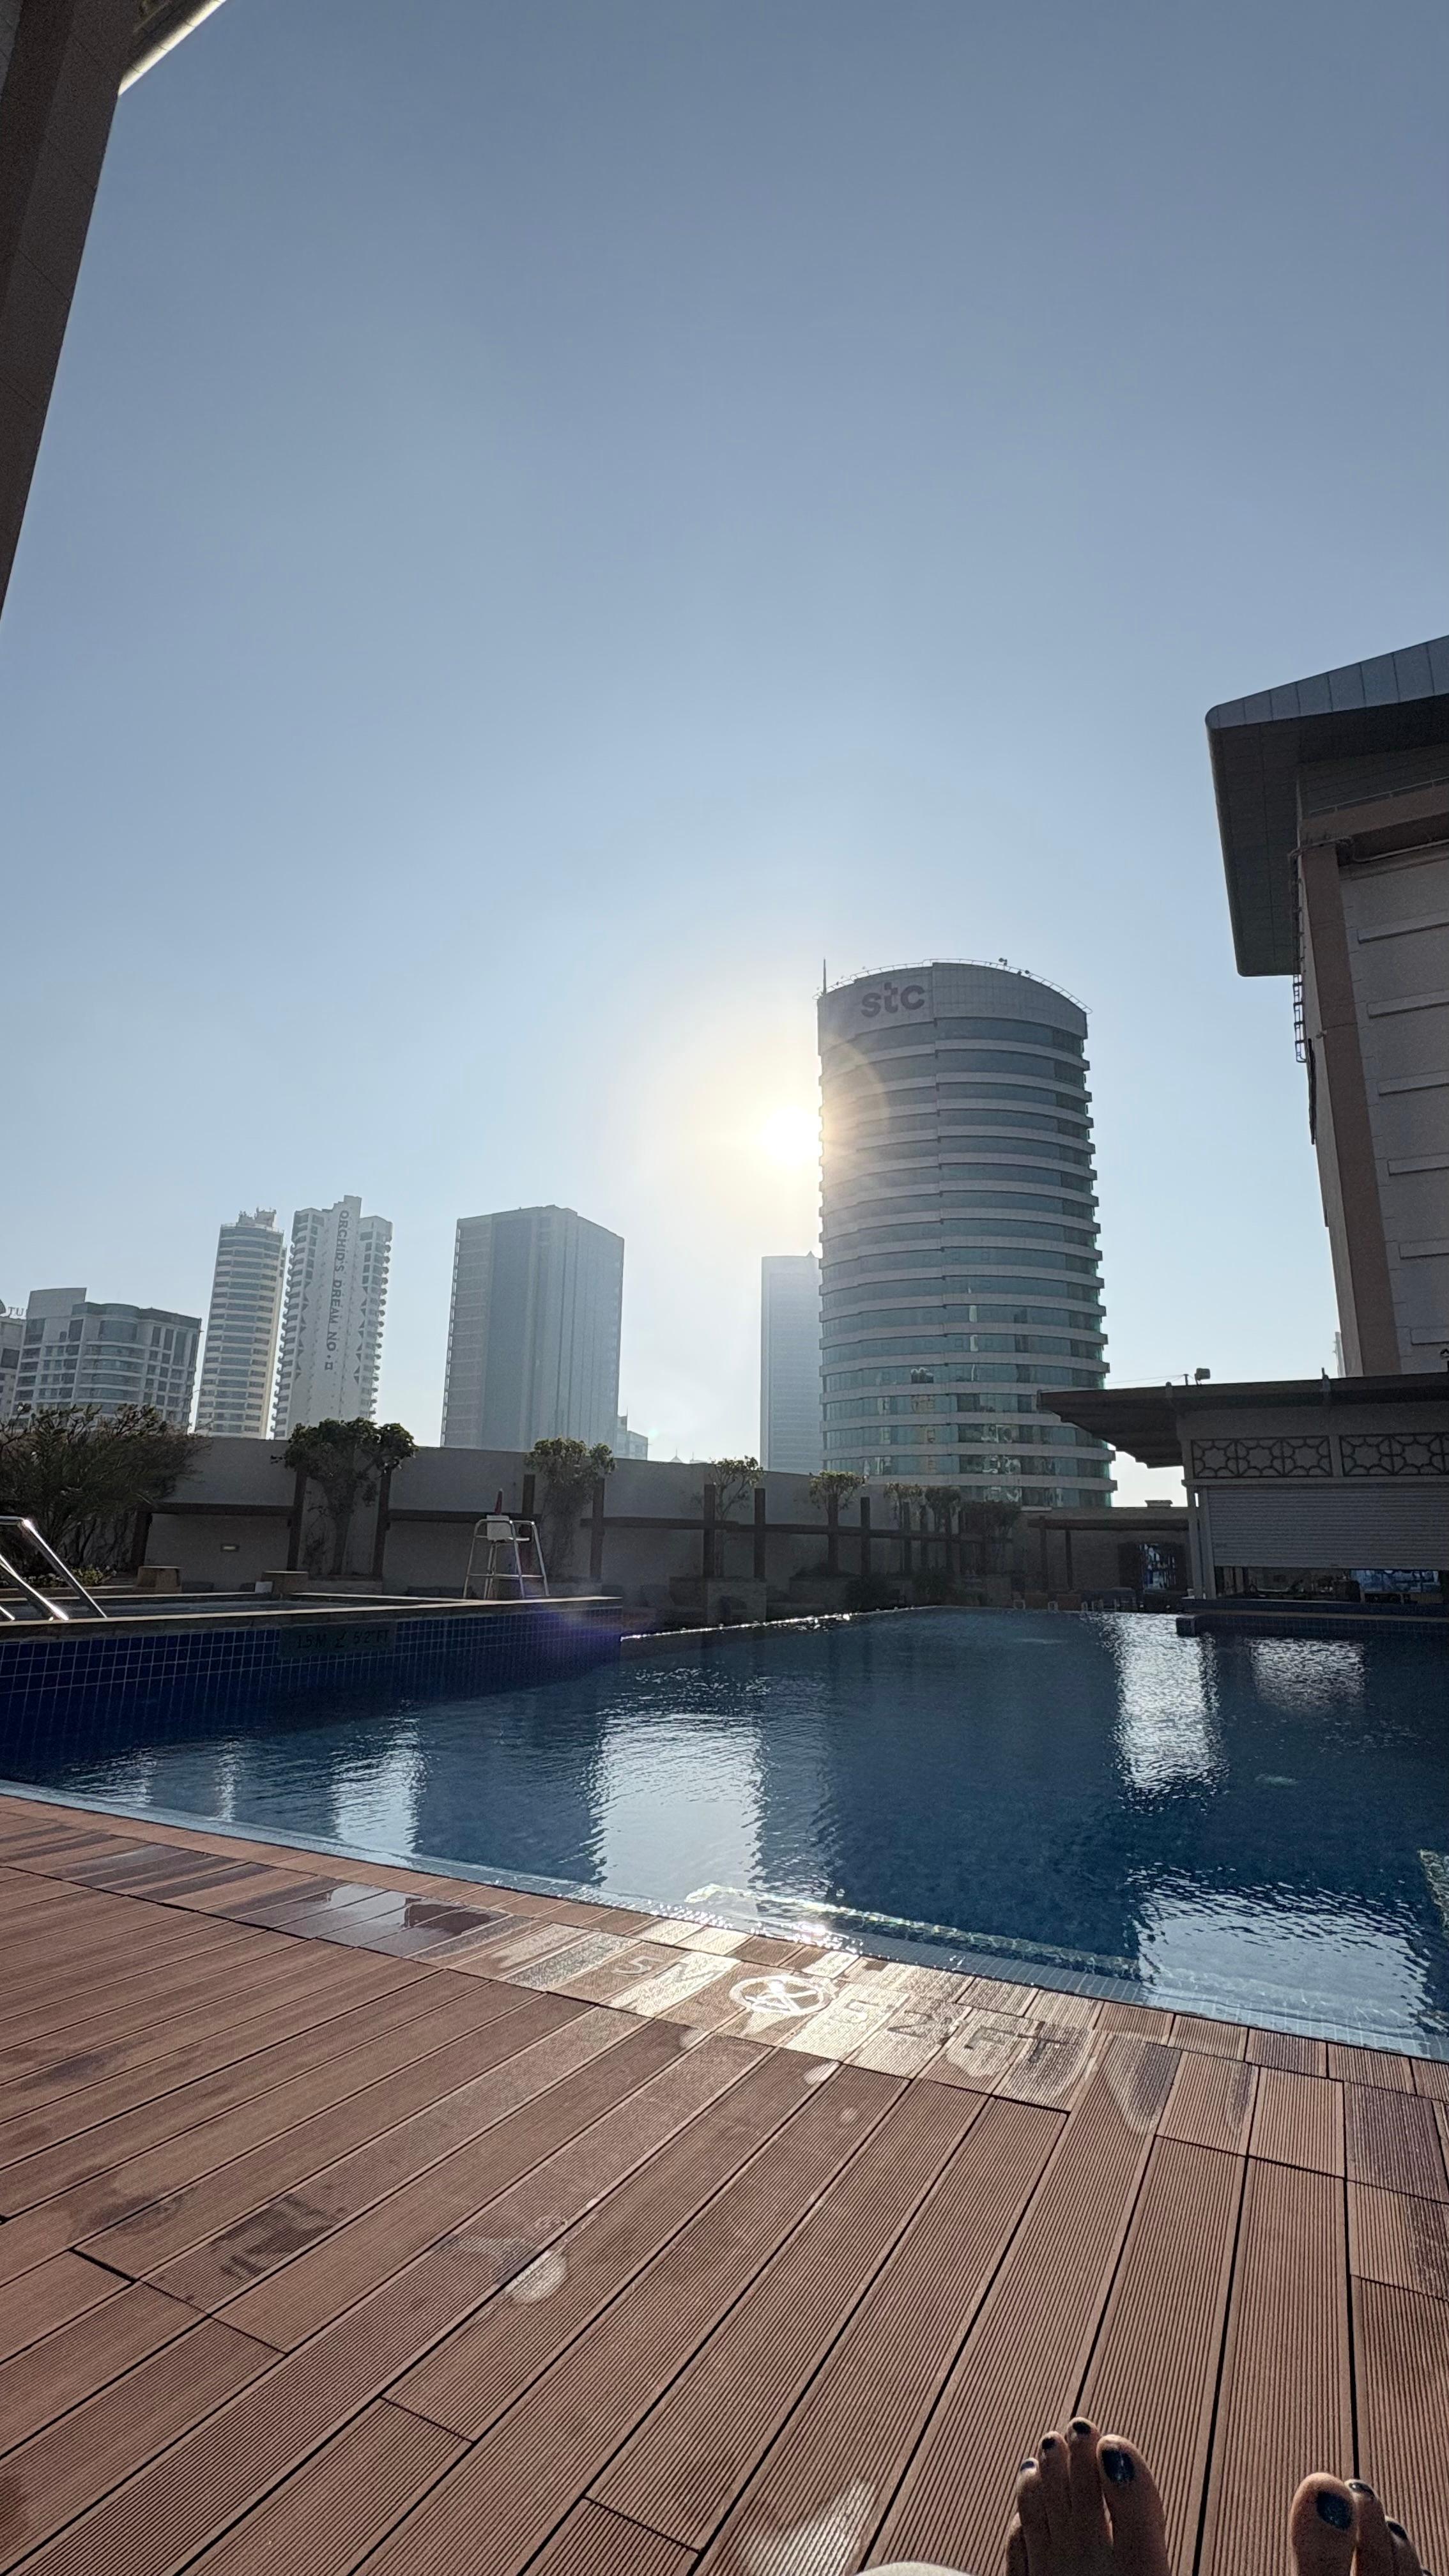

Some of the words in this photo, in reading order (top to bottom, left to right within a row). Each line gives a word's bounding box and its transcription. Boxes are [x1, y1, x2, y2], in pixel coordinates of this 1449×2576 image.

[861, 981, 925, 1018] stc
[335, 1209, 349, 1273] ORCHID'S
[329, 1280, 343, 1324] DREAM
